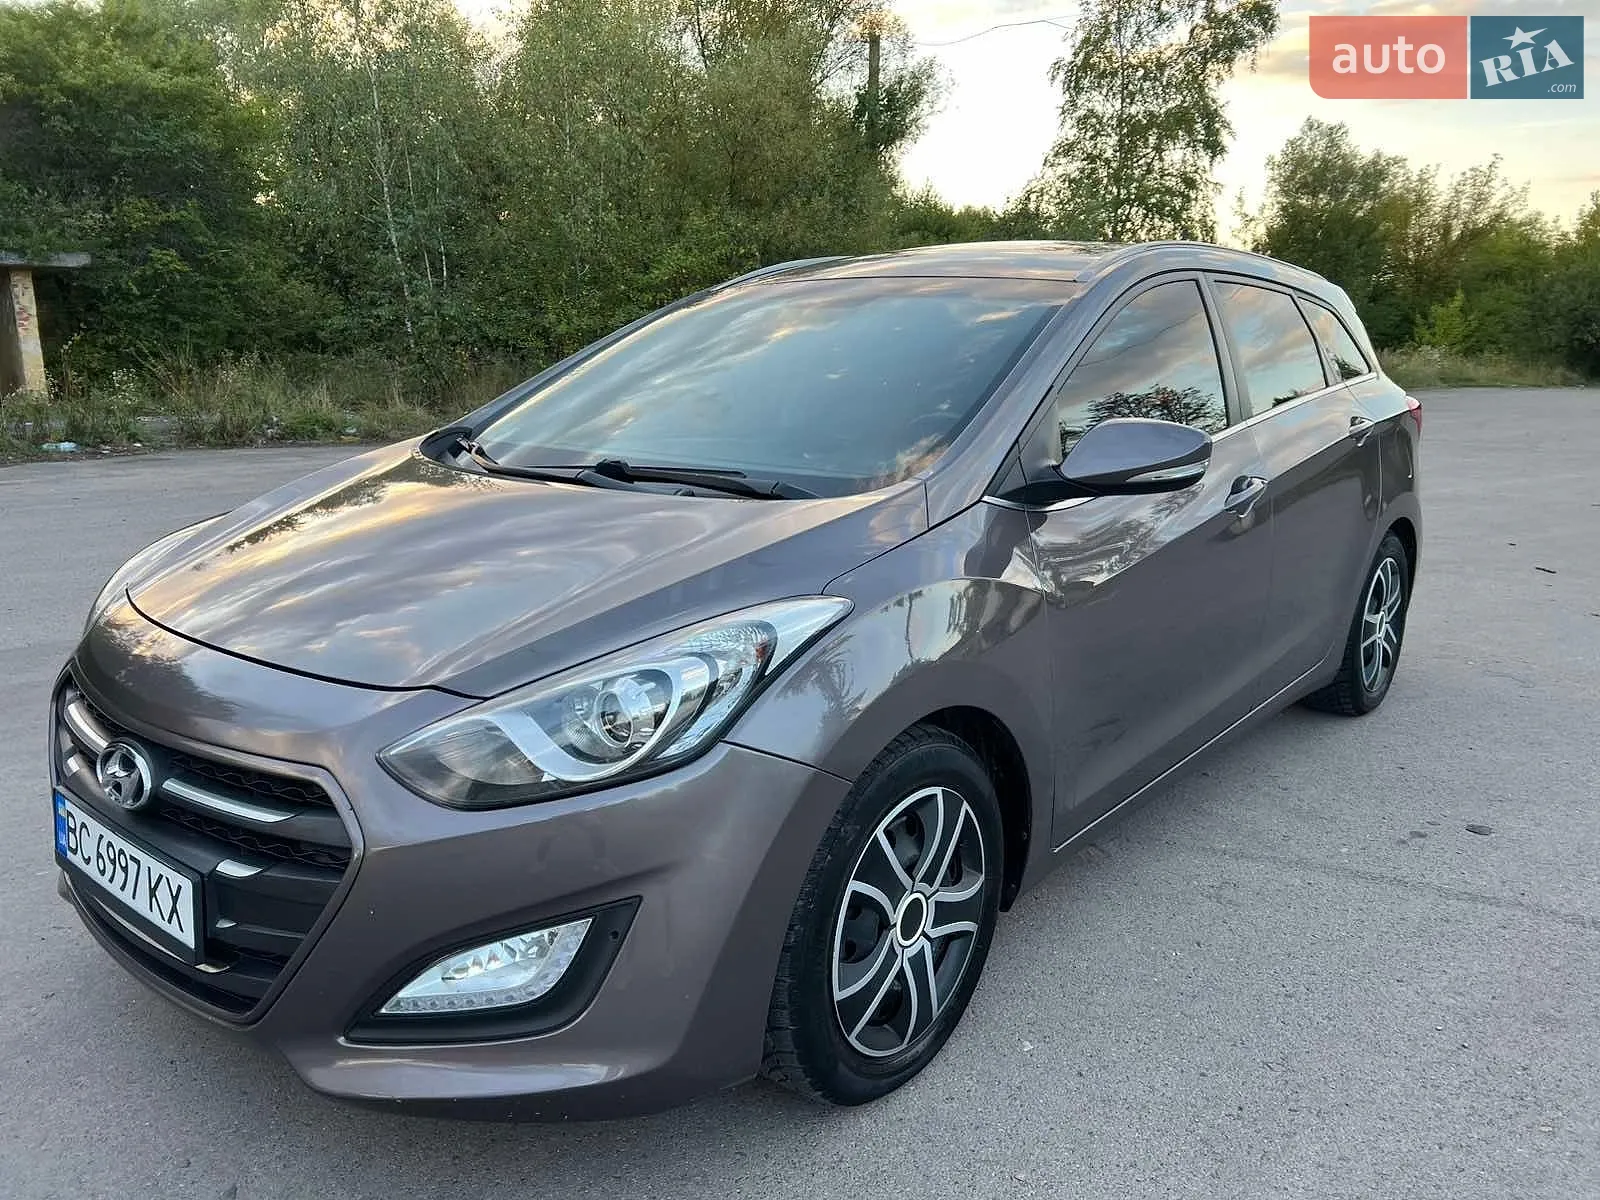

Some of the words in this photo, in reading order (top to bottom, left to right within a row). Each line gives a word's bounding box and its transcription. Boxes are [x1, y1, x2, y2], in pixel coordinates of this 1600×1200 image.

[66, 810, 91, 865] BC
[96, 834, 141, 900] 6997
[147, 866, 184, 933] KX
